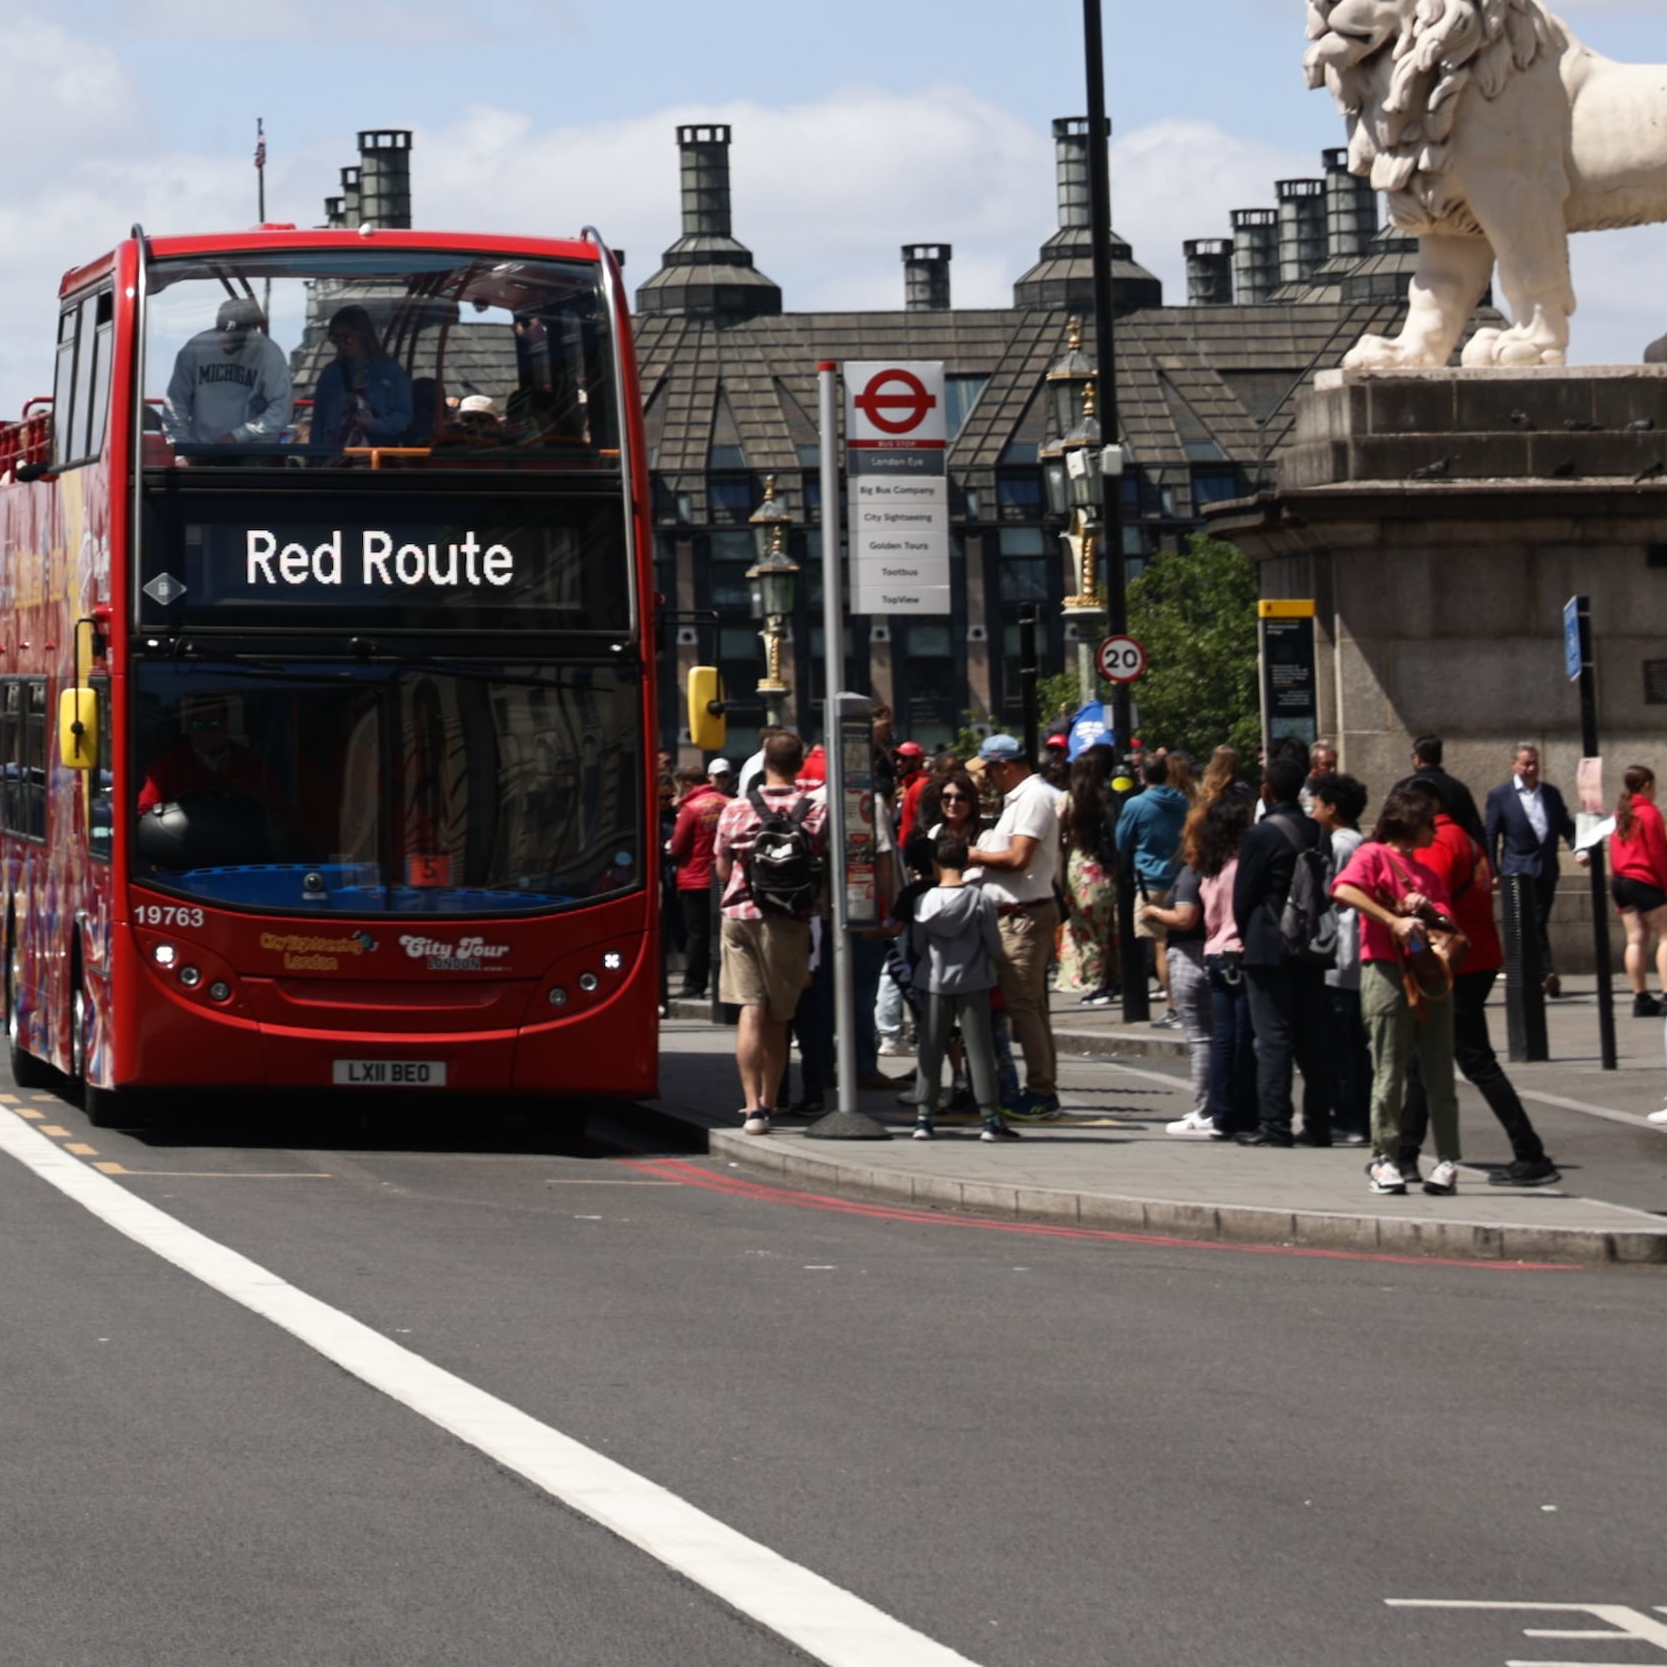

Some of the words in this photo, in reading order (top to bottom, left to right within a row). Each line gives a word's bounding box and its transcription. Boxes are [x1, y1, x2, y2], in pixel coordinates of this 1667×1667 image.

[871, 457, 905, 466] London
[907, 457, 923, 467] Eye
[860, 486, 873, 496] Big
[876, 486, 891, 494] Bus
[893, 486, 935, 497] Company
[864, 513, 881, 523] City
[884, 513, 932, 523] Sightseeing
[869, 542, 902, 550] Golden
[904, 542, 928, 550] Tours
[247, 530, 341, 584] Red
[363, 530, 513, 585] Route
[882, 568, 918, 576] Tootbus
[882, 595, 919, 604] TopView
[1105, 650, 1138, 668] 20
[134, 905, 204, 927] 19763
[398, 935, 453, 957] City
[456, 937, 509, 959] Tour
[427, 957, 481, 970] LONDON
[390, 1063, 430, 1083] BEO
